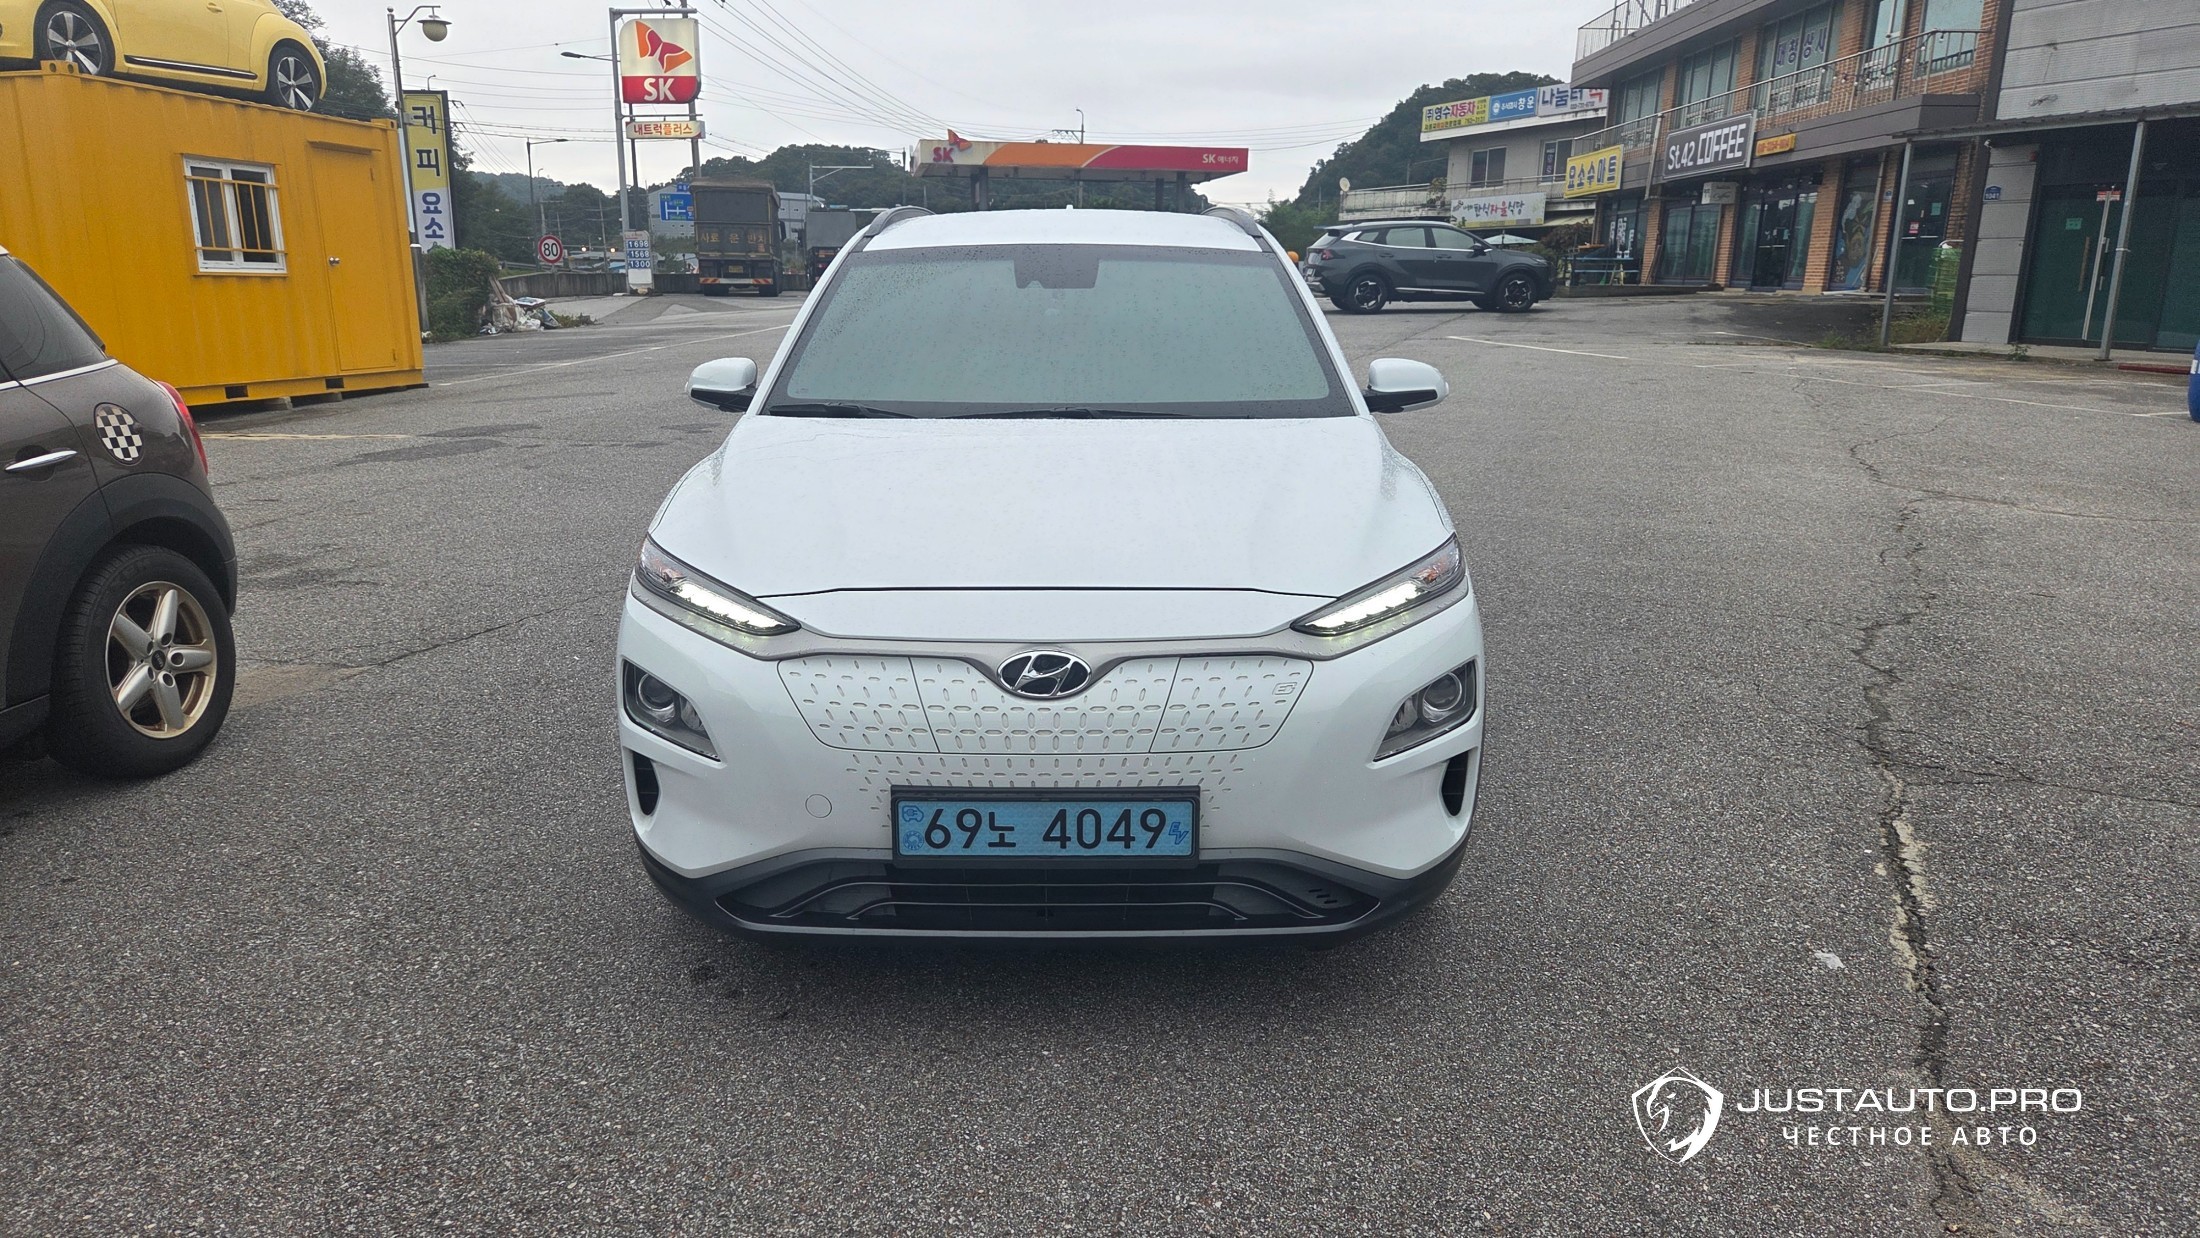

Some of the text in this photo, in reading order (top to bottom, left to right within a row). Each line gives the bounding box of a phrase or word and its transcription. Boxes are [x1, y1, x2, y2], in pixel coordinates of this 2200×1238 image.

[643, 77, 676, 101] SK
[633, 123, 693, 136] 내트럭플러스
[411, 105, 441, 177] 커피
[1696, 123, 1747, 166] COFFEE
[932, 146, 955, 163] SK
[1202, 153, 1216, 164] SK
[1567, 155, 1617, 190] 요소수마트
[543, 242, 559, 257] 80
[630, 260, 651, 268] 1300
[923, 807, 1017, 850] 69노
[1041, 807, 1167, 850] 4049
